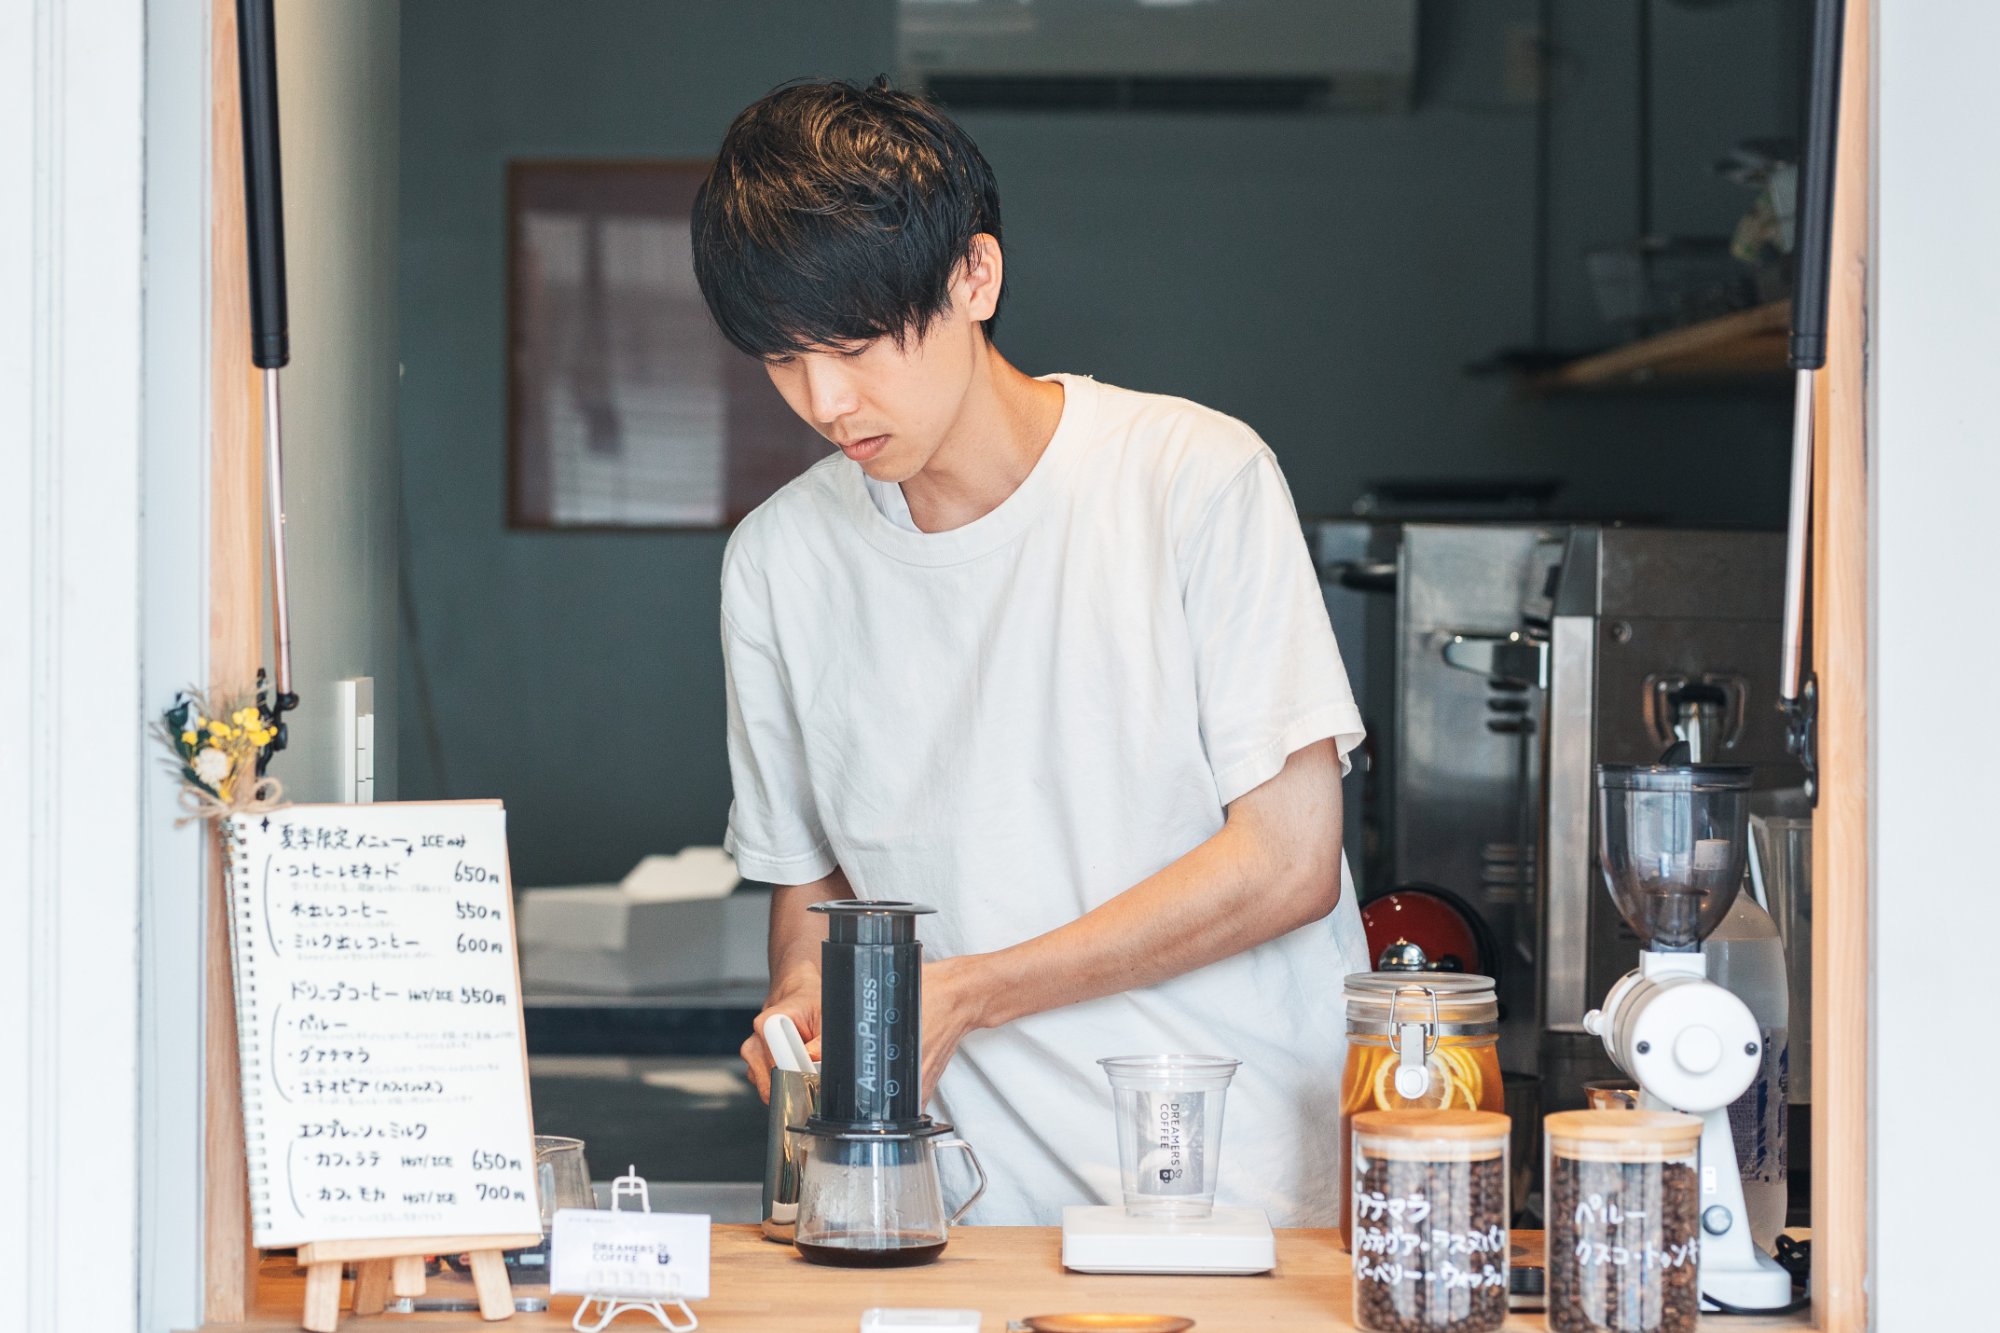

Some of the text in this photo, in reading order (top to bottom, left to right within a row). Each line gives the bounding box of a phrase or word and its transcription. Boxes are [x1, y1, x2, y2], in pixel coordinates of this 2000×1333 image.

[289, 860, 499, 884] コーヒーレモネード 650円
[291, 900, 501, 920] 水出しコーヒー 550円
[295, 933, 502, 954] ミルク出しコーヒー 600円
[292, 981, 398, 1001] ドリップコーヒー
[460, 987, 506, 1005] 550円
[299, 1014, 347, 1031] ペルー
[300, 1046, 370, 1063] グアテマラ
[1160, 1103, 1169, 1150] COFFEE
[1170, 1103, 1180, 1166] DREAMERS
[316, 1151, 380, 1167] カフェラテ
[472, 1149, 522, 1171] 650円
[320, 1186, 385, 1202] カフェモカ
[475, 1183, 525, 1202] 700円
[1574, 1194, 1647, 1225] ペルー
